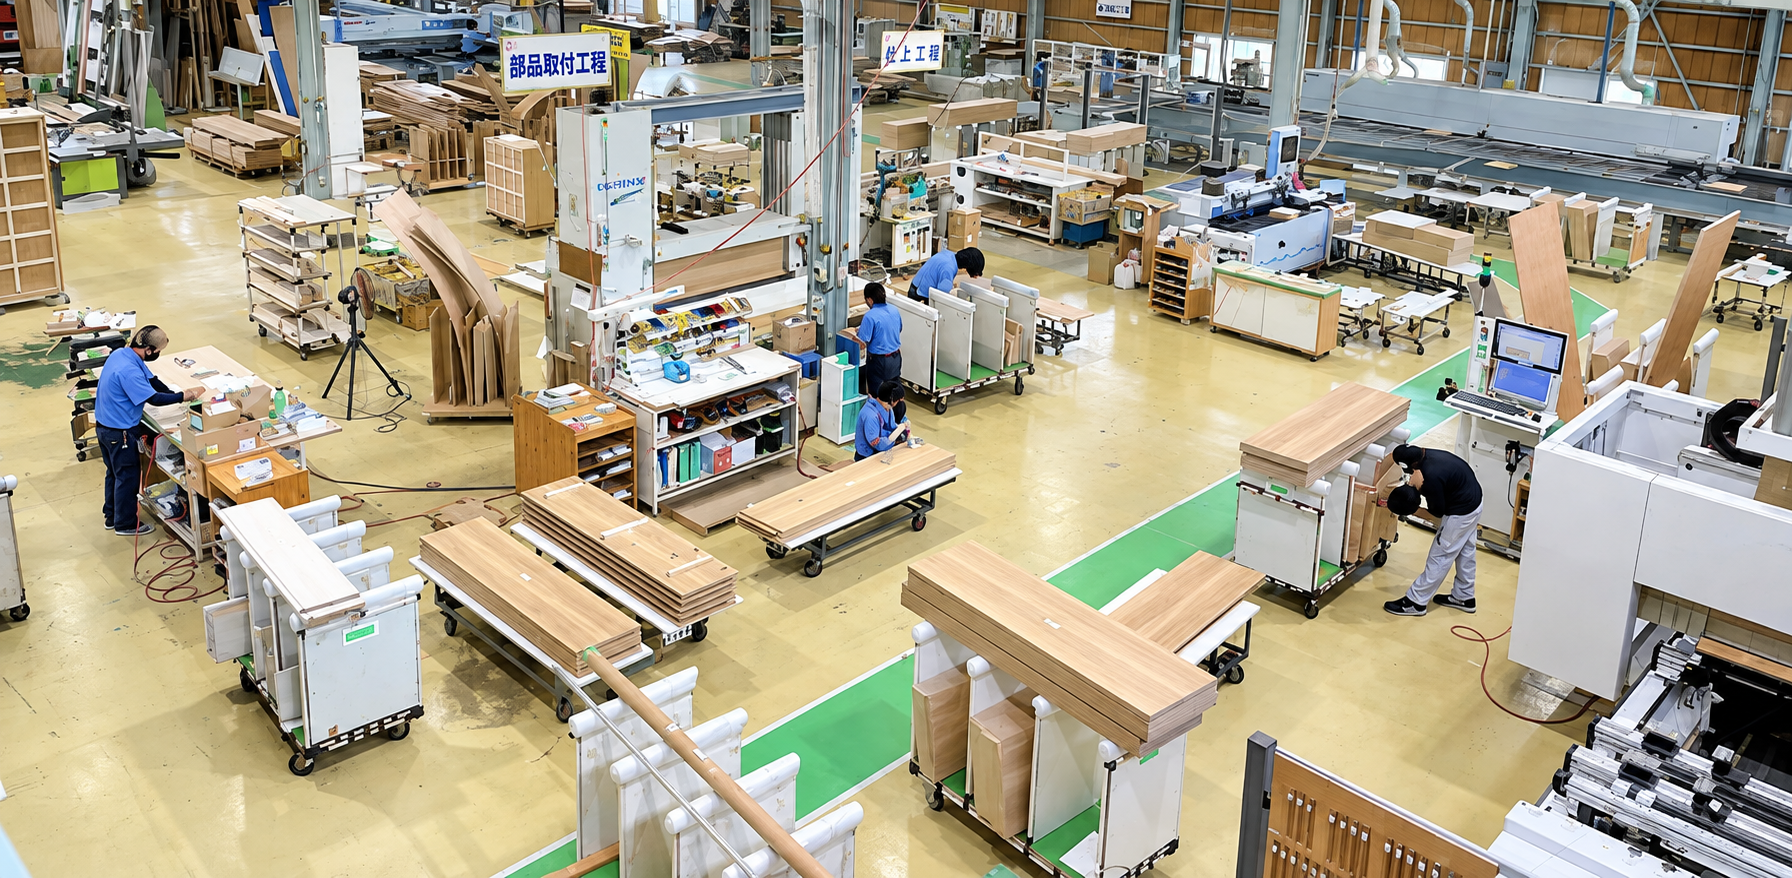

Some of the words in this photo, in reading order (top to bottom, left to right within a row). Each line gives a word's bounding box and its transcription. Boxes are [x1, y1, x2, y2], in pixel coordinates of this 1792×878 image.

[509, 50, 607, 79] 部品取付工程
